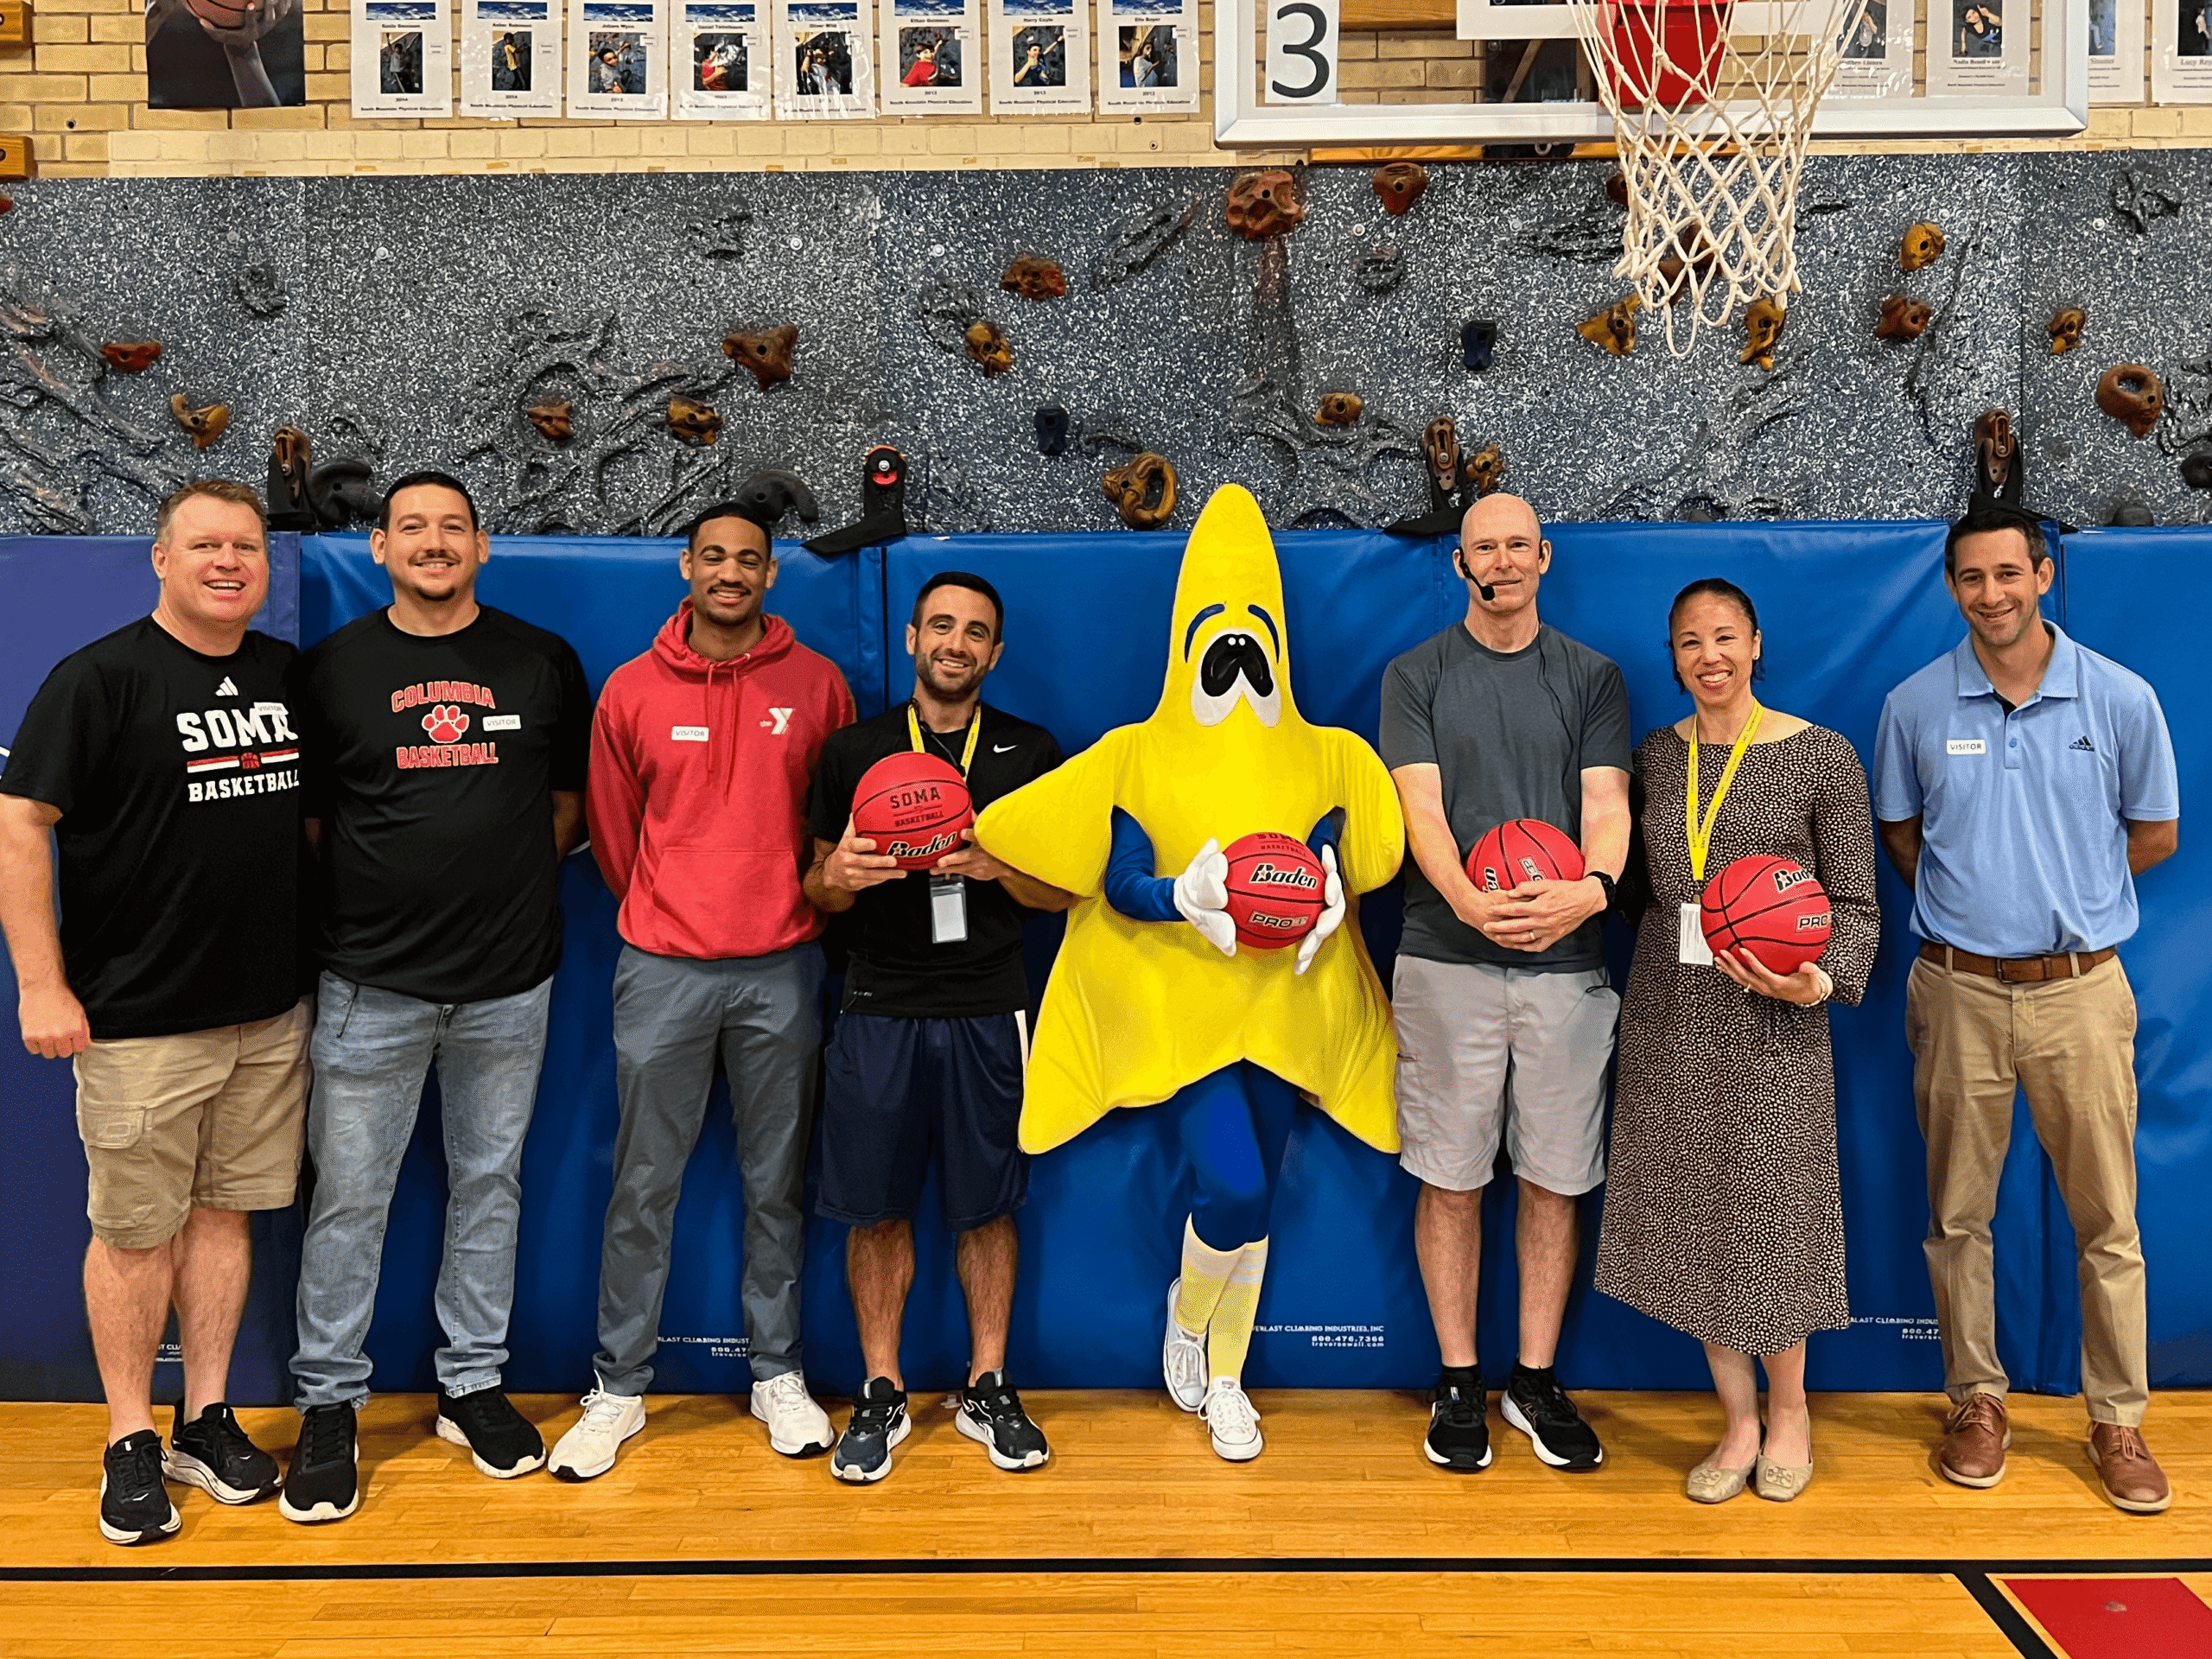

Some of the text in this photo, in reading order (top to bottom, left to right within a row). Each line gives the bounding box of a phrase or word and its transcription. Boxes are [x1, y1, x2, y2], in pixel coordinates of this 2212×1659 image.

[1271, 3, 1330, 99] 3
[391, 680, 496, 713] COLUMBIA
[486, 718, 517, 727] VISITOR
[396, 741, 499, 769] BASKETBALL
[1949, 742, 1982, 751] VISITOR
[188, 769, 300, 803] BASKETBALL
[889, 787, 941, 810] SOMA
[894, 810, 944, 828] BASKETBALL
[887, 831, 959, 858] Baden
[1261, 844, 1306, 856] BASKETBALL
[1249, 862, 1319, 891] Baden
[1250, 912, 1294, 929] PRO
